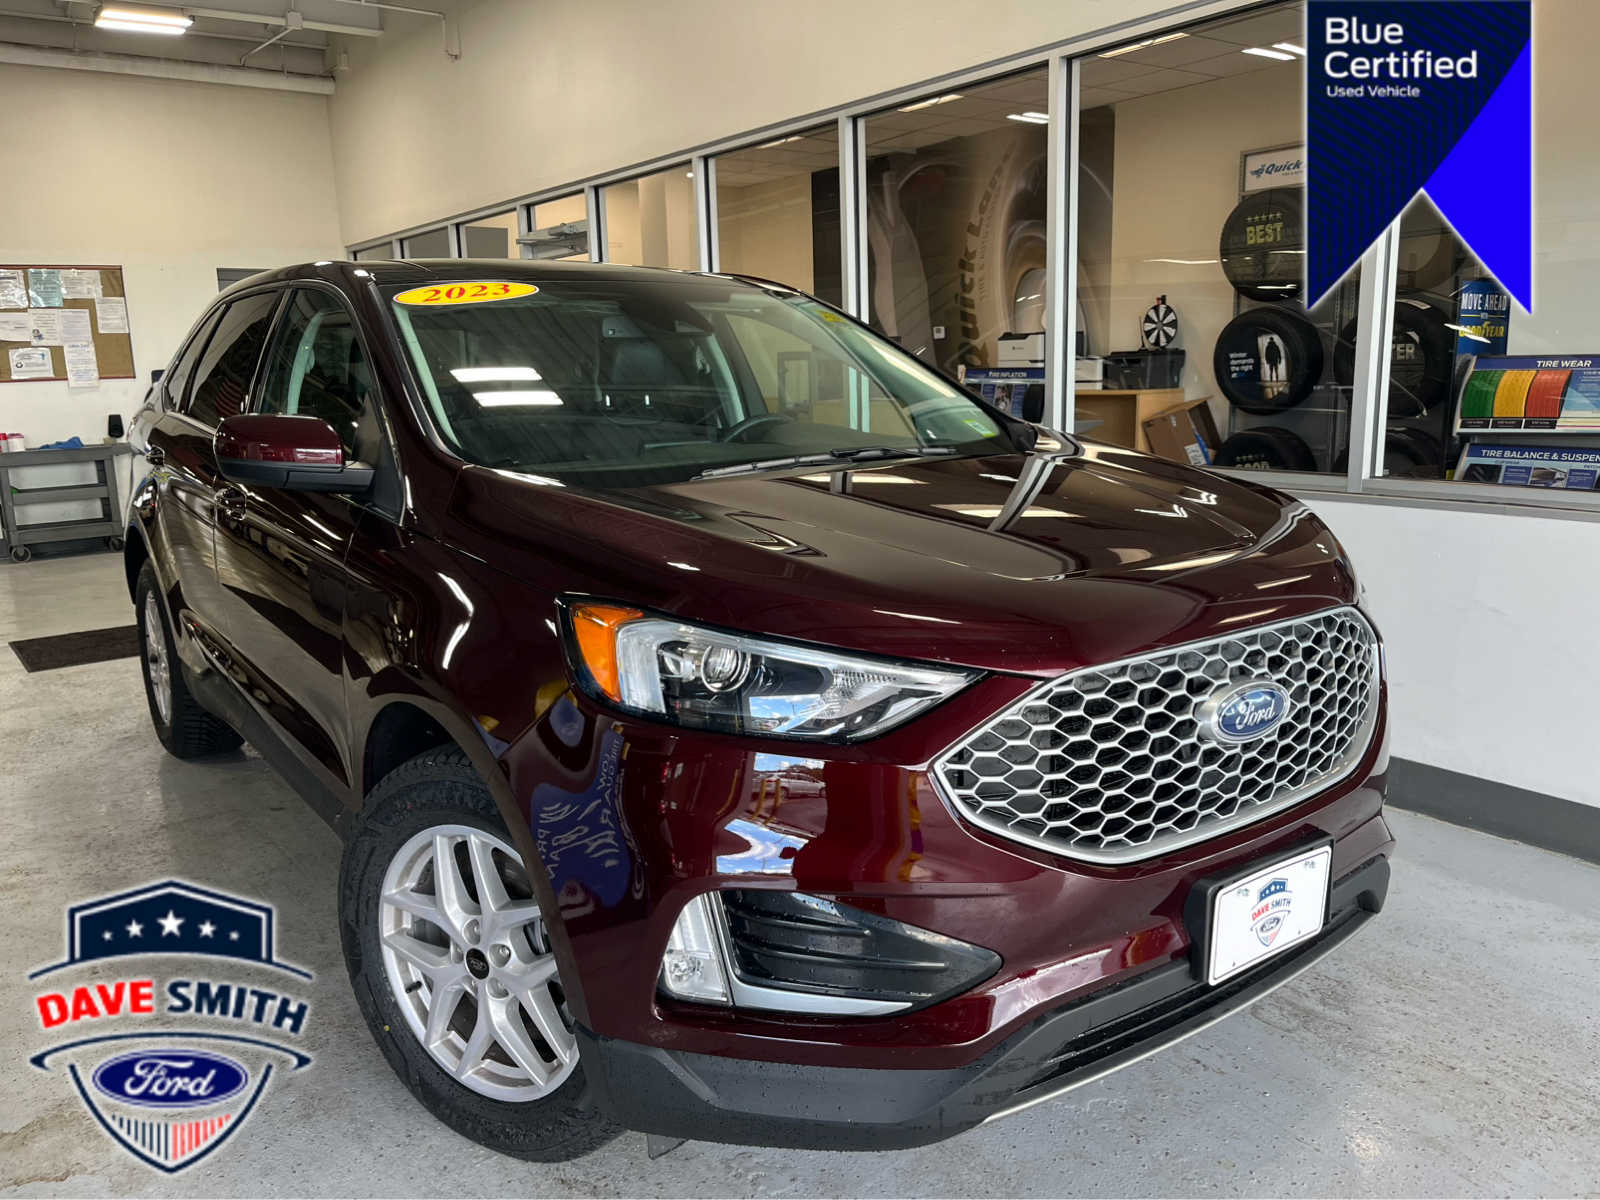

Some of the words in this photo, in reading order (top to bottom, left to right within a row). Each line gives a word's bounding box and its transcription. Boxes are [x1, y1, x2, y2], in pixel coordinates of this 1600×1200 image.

[1246, 222, 1284, 245] BEST
[423, 284, 511, 303] 2023
[1461, 293, 1483, 310] MOVE
[1484, 294, 1507, 311] AHEAD
[1536, 360, 1558, 368] TIRE
[1560, 360, 1592, 368] WEAR
[1481, 449, 1503, 457] TIRE
[1504, 450, 1550, 460] BALANCE
[1551, 452, 1559, 460] &
[1235, 694, 1276, 730] Ford
[1251, 903, 1270, 921] DAVE
[1270, 897, 1292, 910] SMITH
